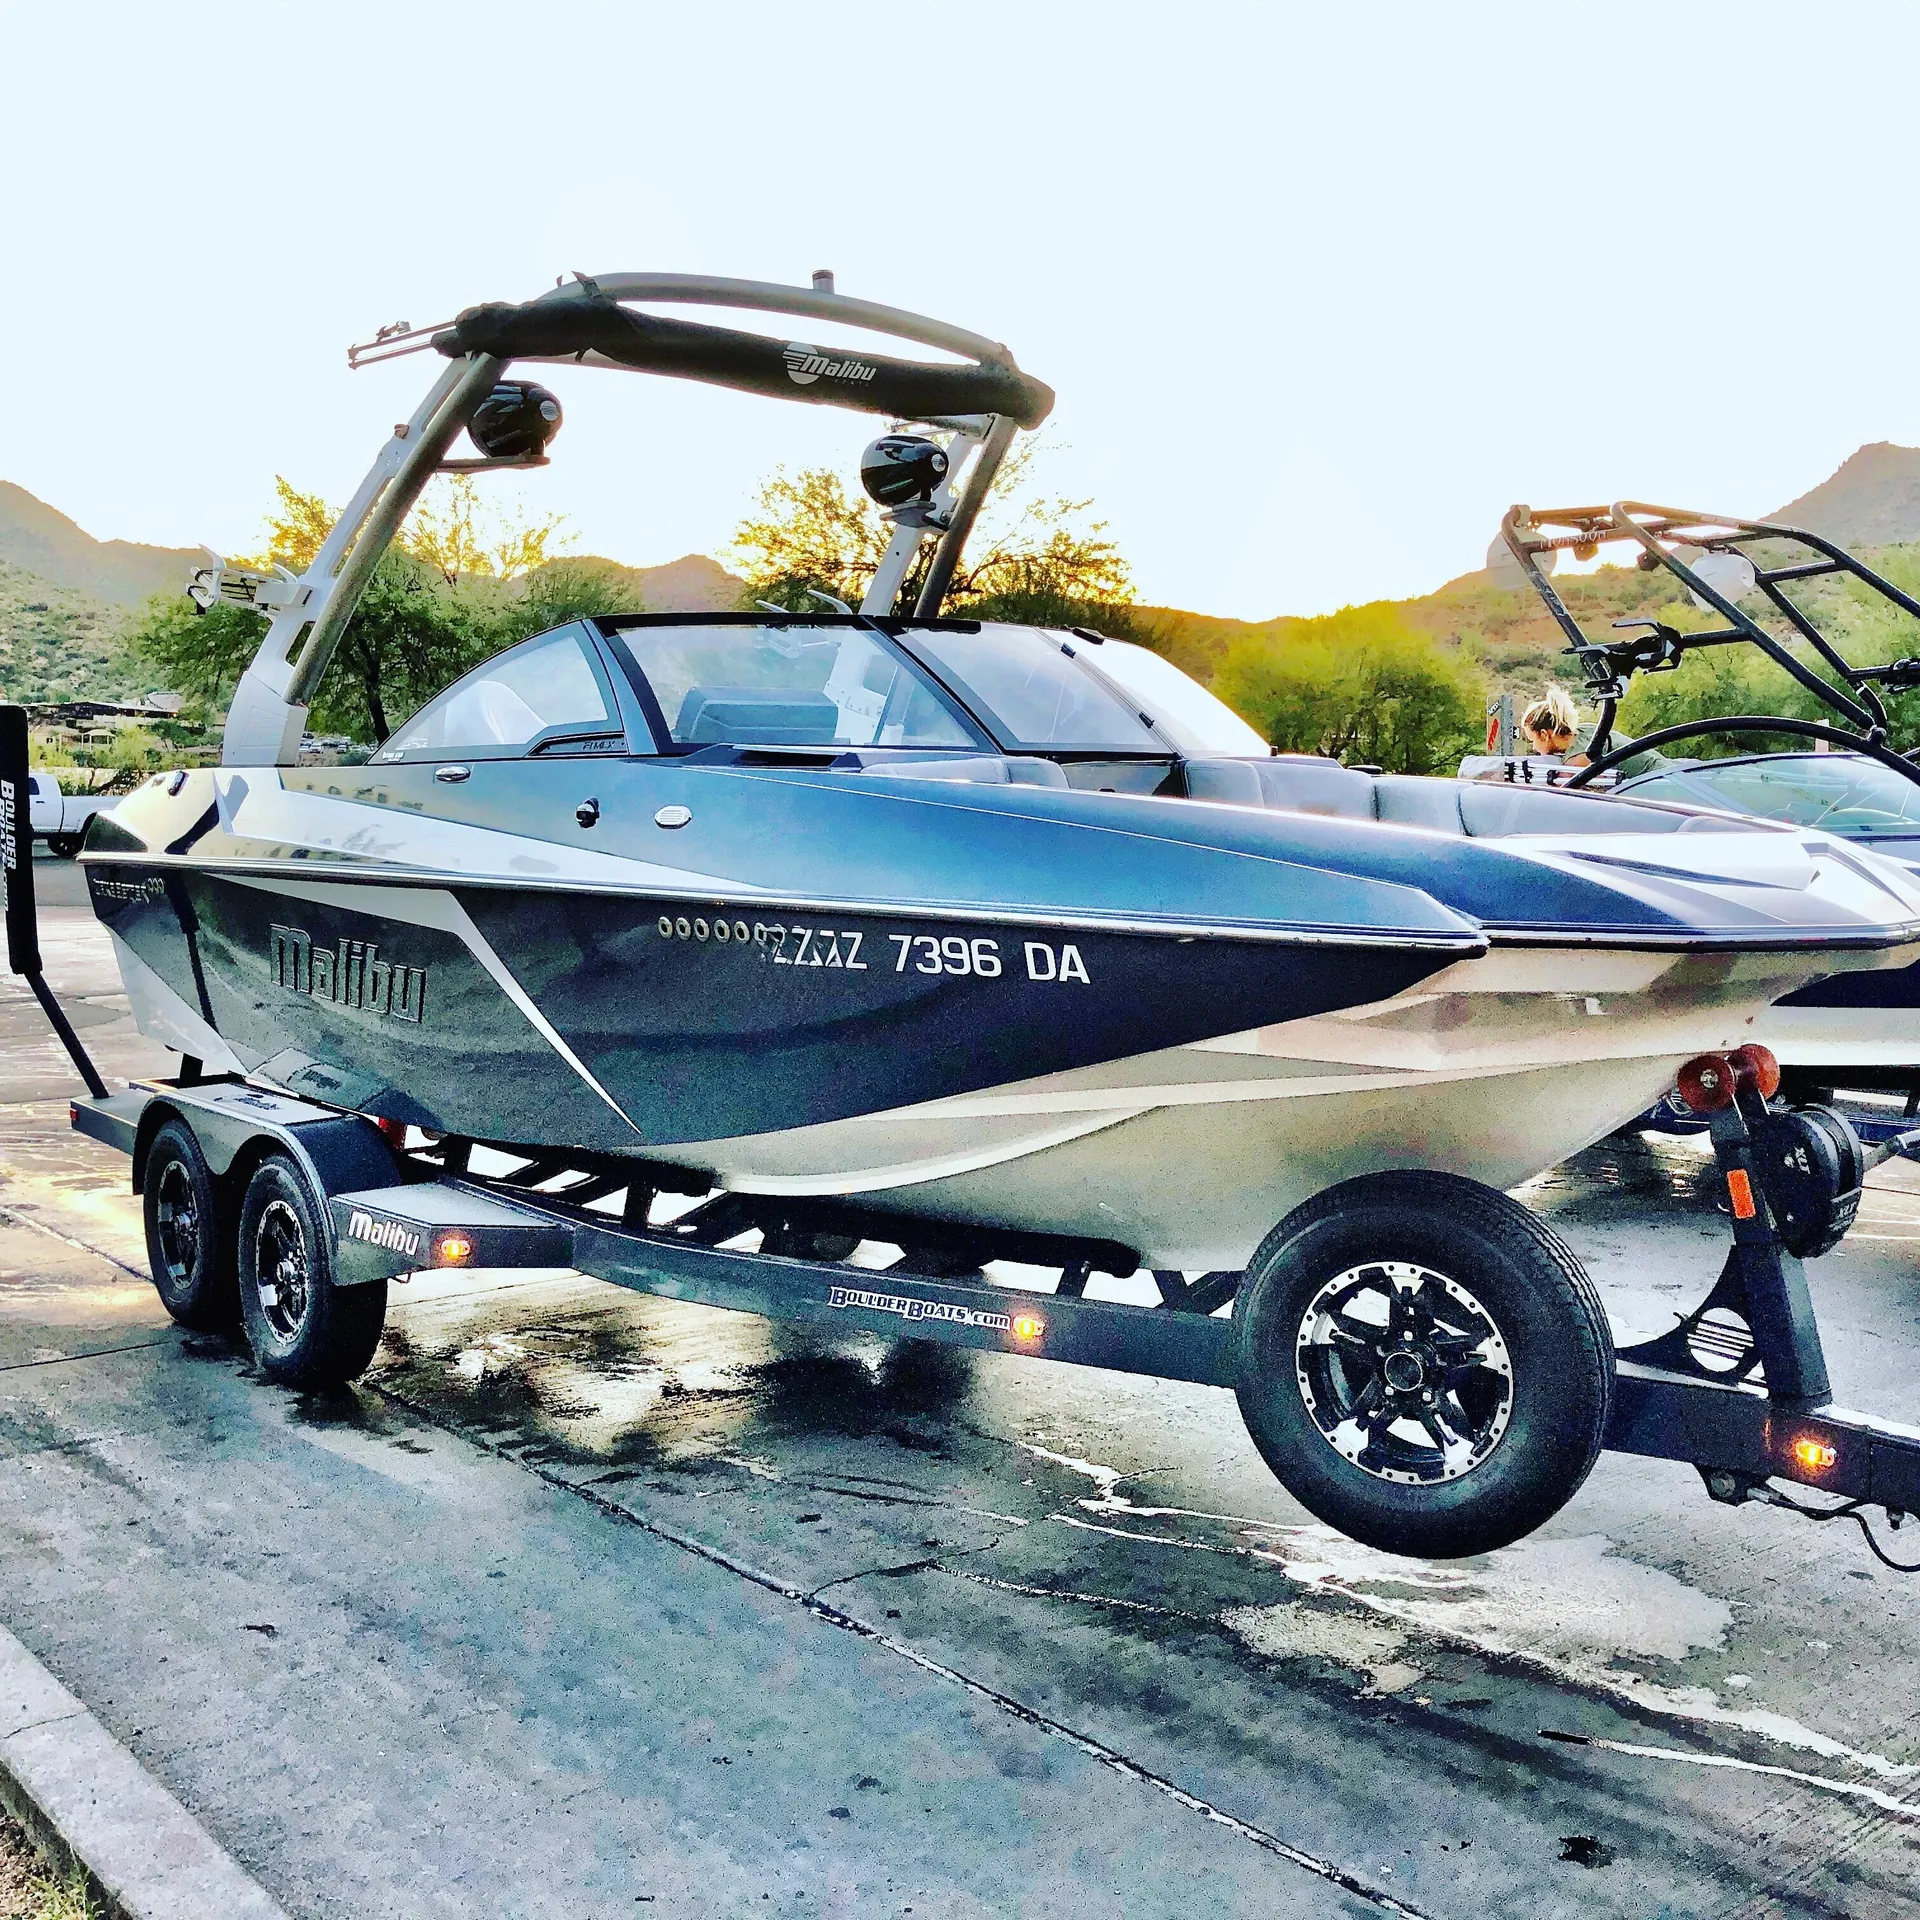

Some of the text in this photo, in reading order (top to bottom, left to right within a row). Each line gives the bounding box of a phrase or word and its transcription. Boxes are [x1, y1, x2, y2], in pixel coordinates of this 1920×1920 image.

[800, 355, 878, 381] Malibu
[269, 923, 427, 1024] Malibu
[888, 933, 1002, 977] 7396
[1023, 941, 1091, 984] DA
[348, 1211, 420, 1256] Malibu
